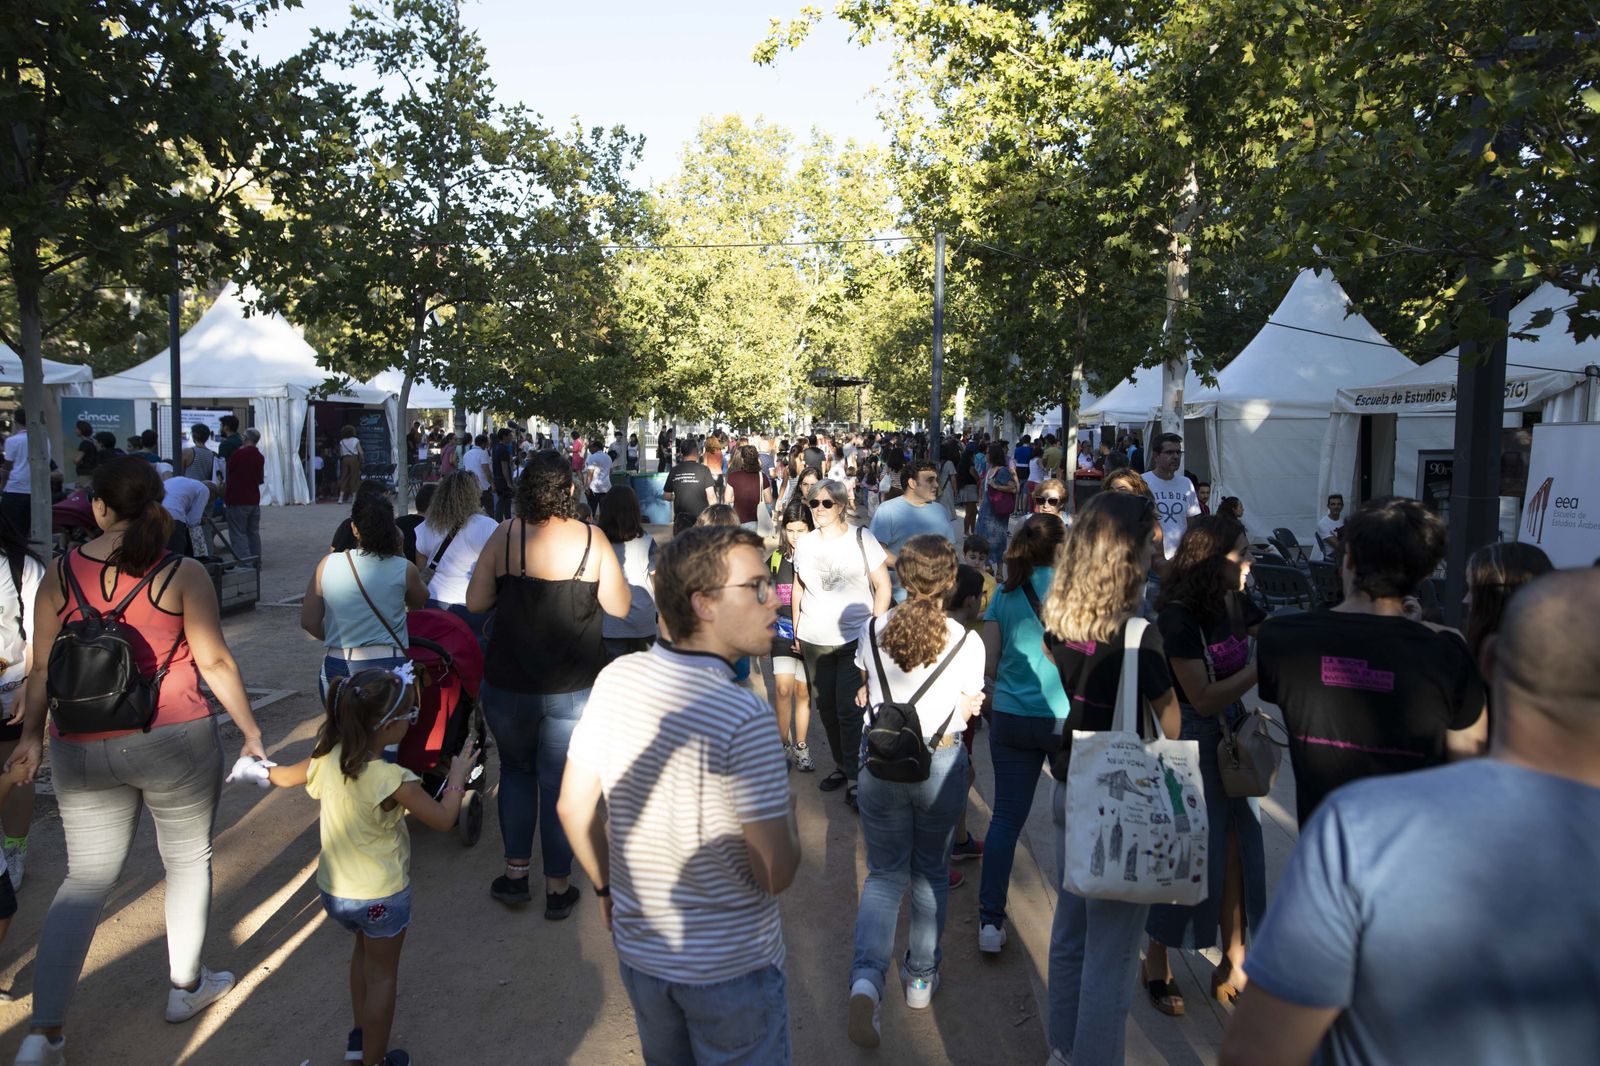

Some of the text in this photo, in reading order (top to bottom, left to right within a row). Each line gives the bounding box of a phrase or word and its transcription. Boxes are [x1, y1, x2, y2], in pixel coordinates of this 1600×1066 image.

[1355, 393, 1389, 406] Escuela
[1391, 391, 1402, 405] de
[1405, 388, 1446, 404] Estudios
[1555, 497, 1579, 509] eea
